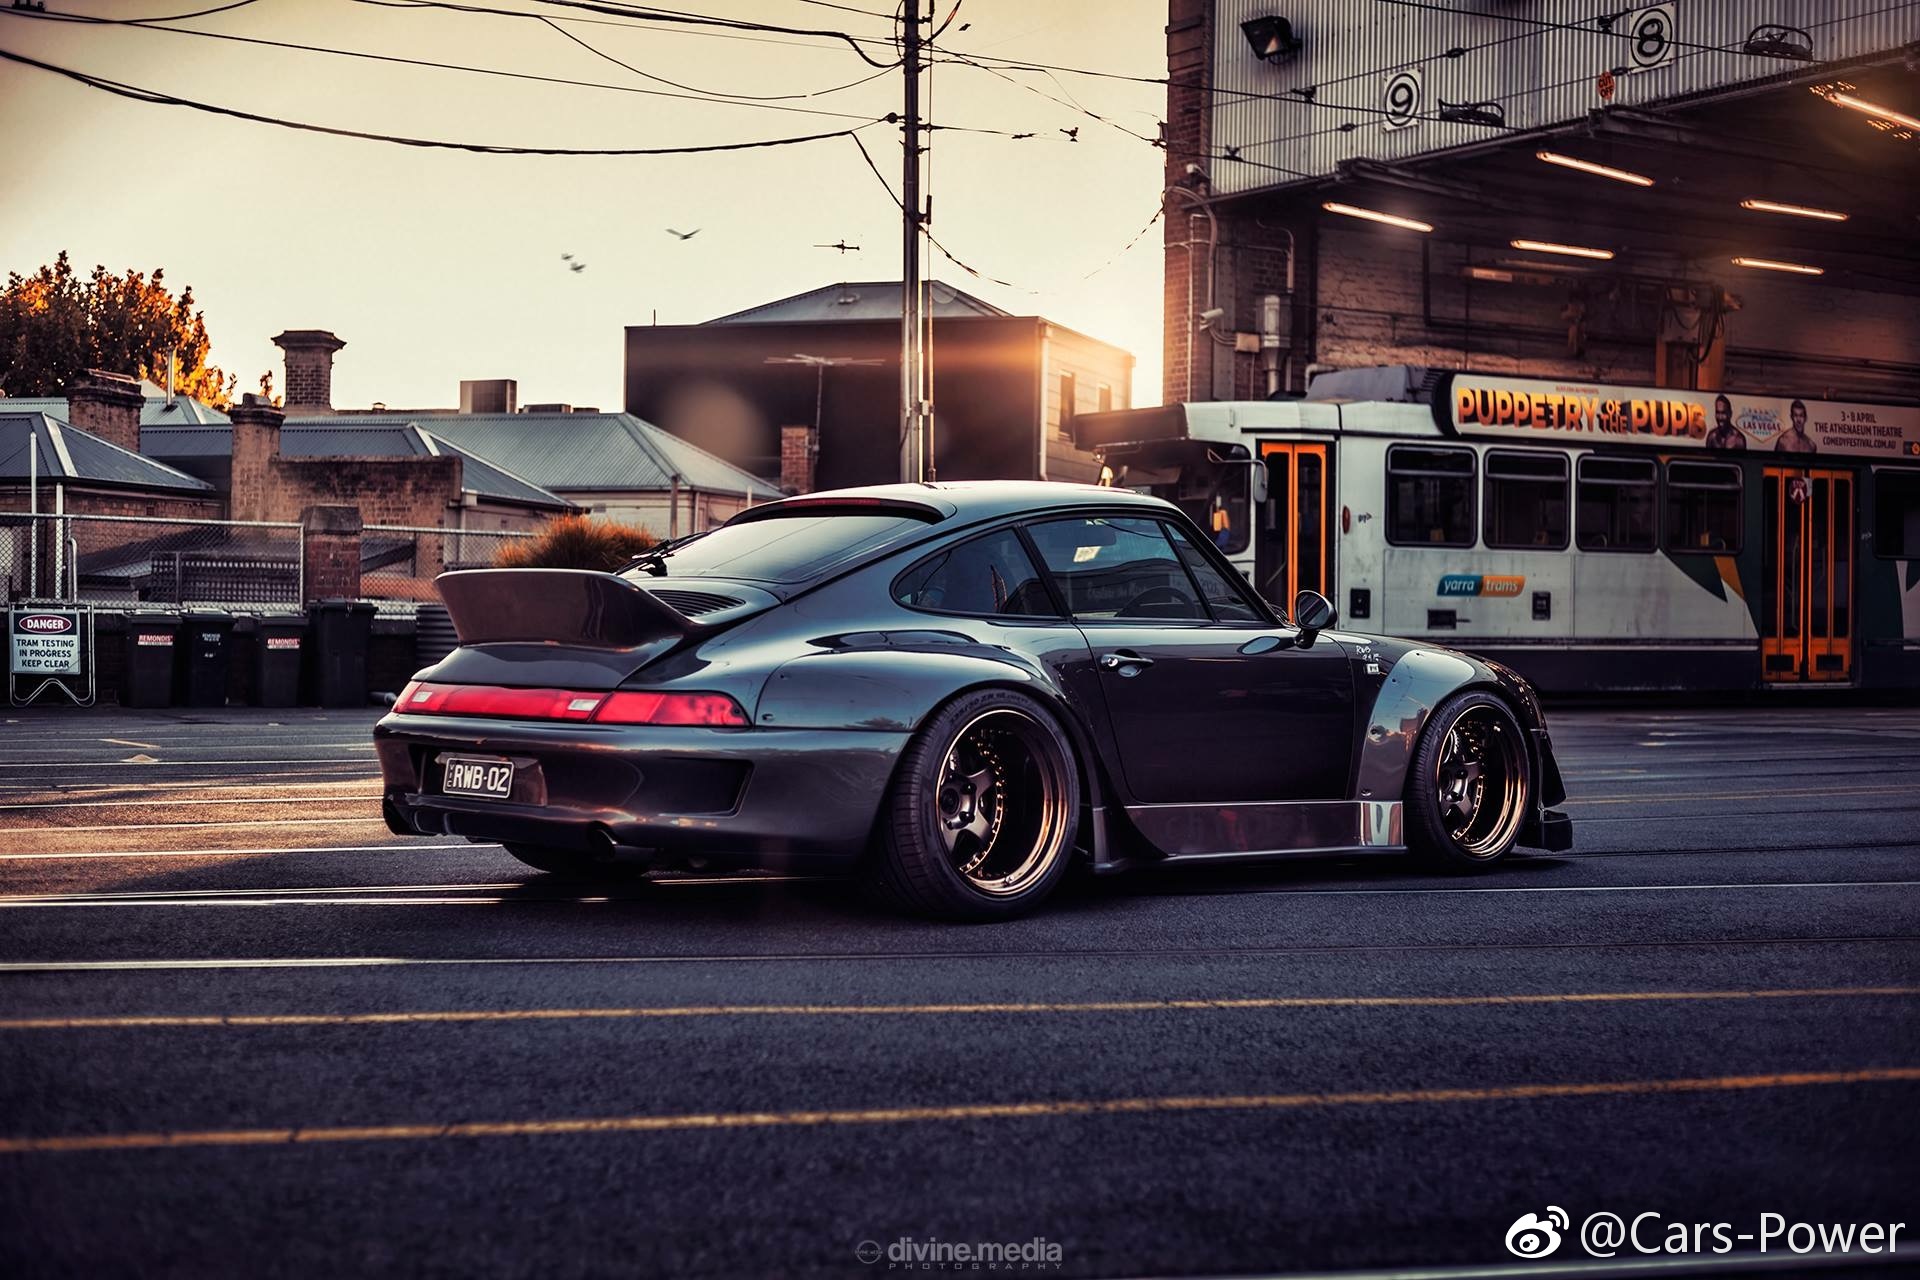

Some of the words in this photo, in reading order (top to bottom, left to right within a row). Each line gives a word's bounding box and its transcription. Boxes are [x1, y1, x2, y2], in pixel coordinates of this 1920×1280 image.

[1637, 18, 1665, 57] 8
[1598, 76, 1613, 88] CUT
[1600, 87, 1614, 98] OFF
[1391, 83, 1413, 116] 9
[1456, 387, 1599, 432] PUPPETRY
[1605, 399, 1622, 415] OF
[1600, 413, 1628, 434] THE
[1857, 412, 1877, 424] APRIL
[1743, 421, 1757, 430] LAS
[1758, 423, 1781, 432] VEGAS
[1814, 422, 1829, 433] THE
[1829, 423, 1872, 436] ATHENAEUM
[1872, 425, 1903, 438] THEATRE
[1822, 436, 1896, 449] COMEDYFESTIVAL.COM.AU
[1444, 580, 1475, 594] yarra
[1486, 580, 1518, 593] trams
[26, 619, 64, 630] DANGER
[16, 639, 39, 647] TRAM
[41, 639, 75, 648] TESTING
[19, 649, 28, 657] IN
[29, 649, 72, 658] PROGRESS
[21, 659, 42, 668] KEEP
[44, 660, 70, 668] CLEAR
